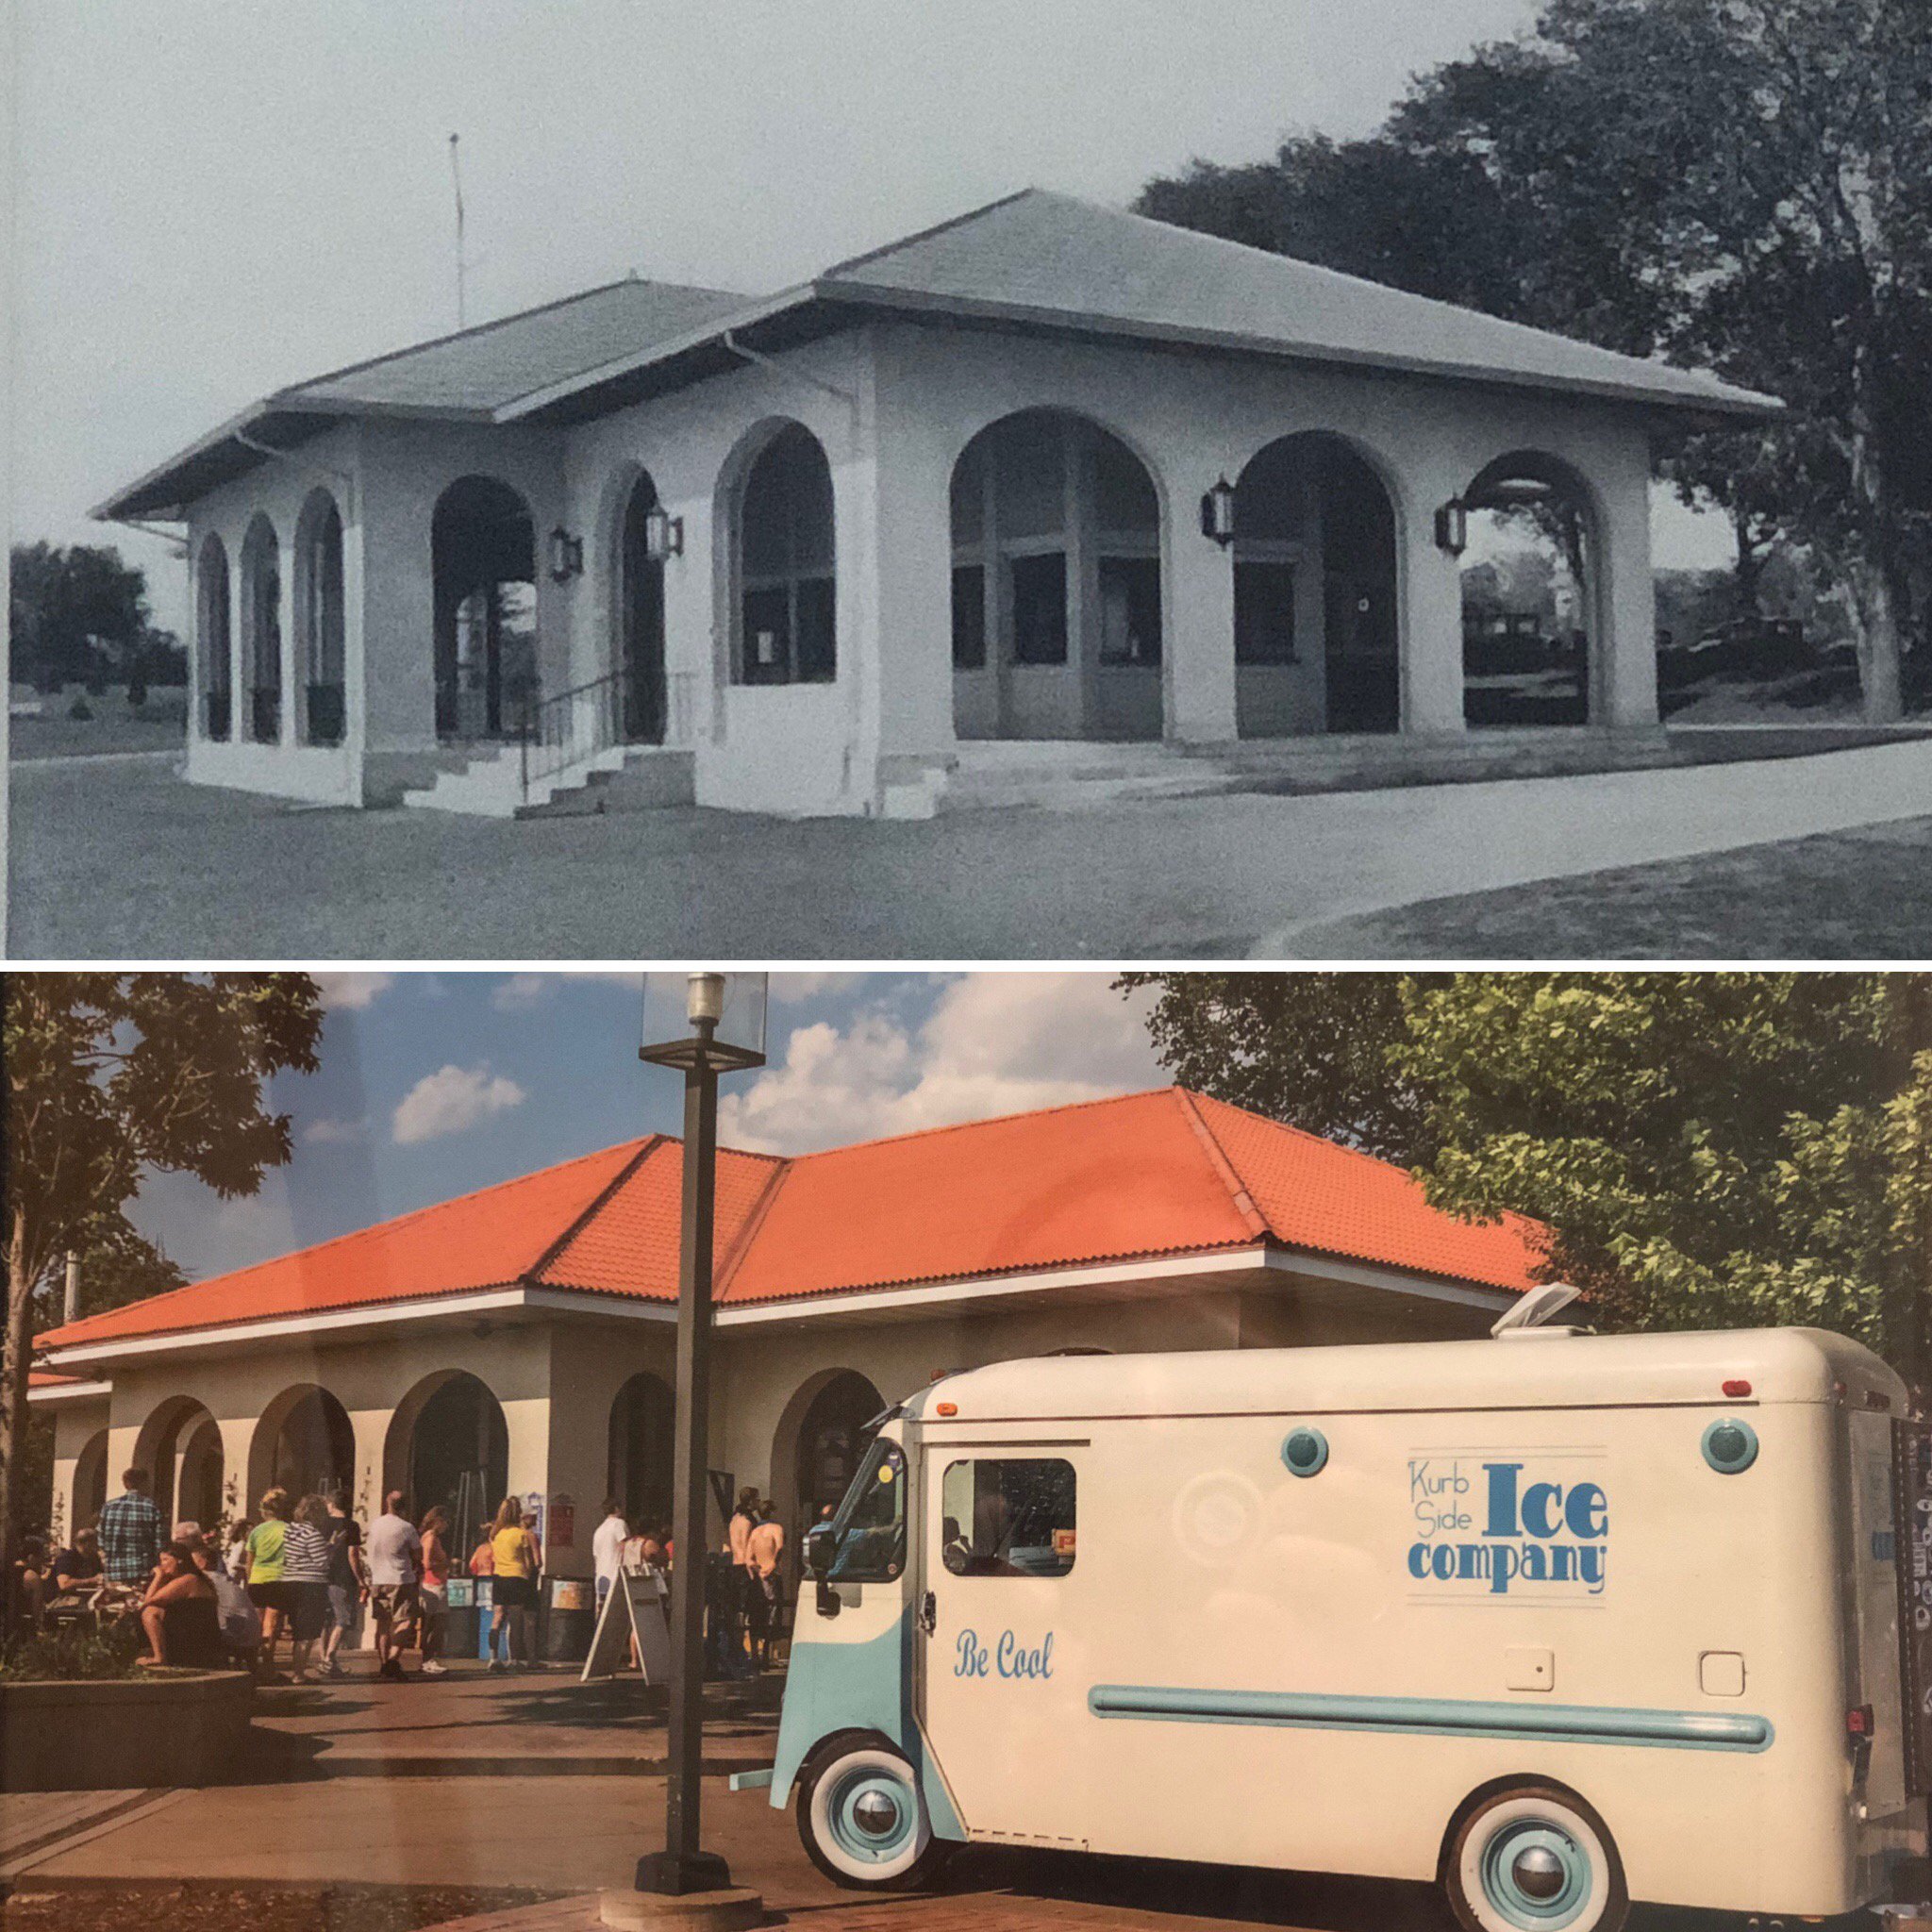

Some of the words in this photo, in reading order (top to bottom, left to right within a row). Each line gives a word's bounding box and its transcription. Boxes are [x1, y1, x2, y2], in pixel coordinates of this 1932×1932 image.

[1407, 1461, 1470, 1503] Kurb
[1481, 1463, 1608, 1539] Ice
[1415, 1499, 1473, 1538] Side
[1407, 1541, 1607, 1594] company
[954, 1628, 990, 1677] Be
[996, 1629, 1054, 1679] Cool
